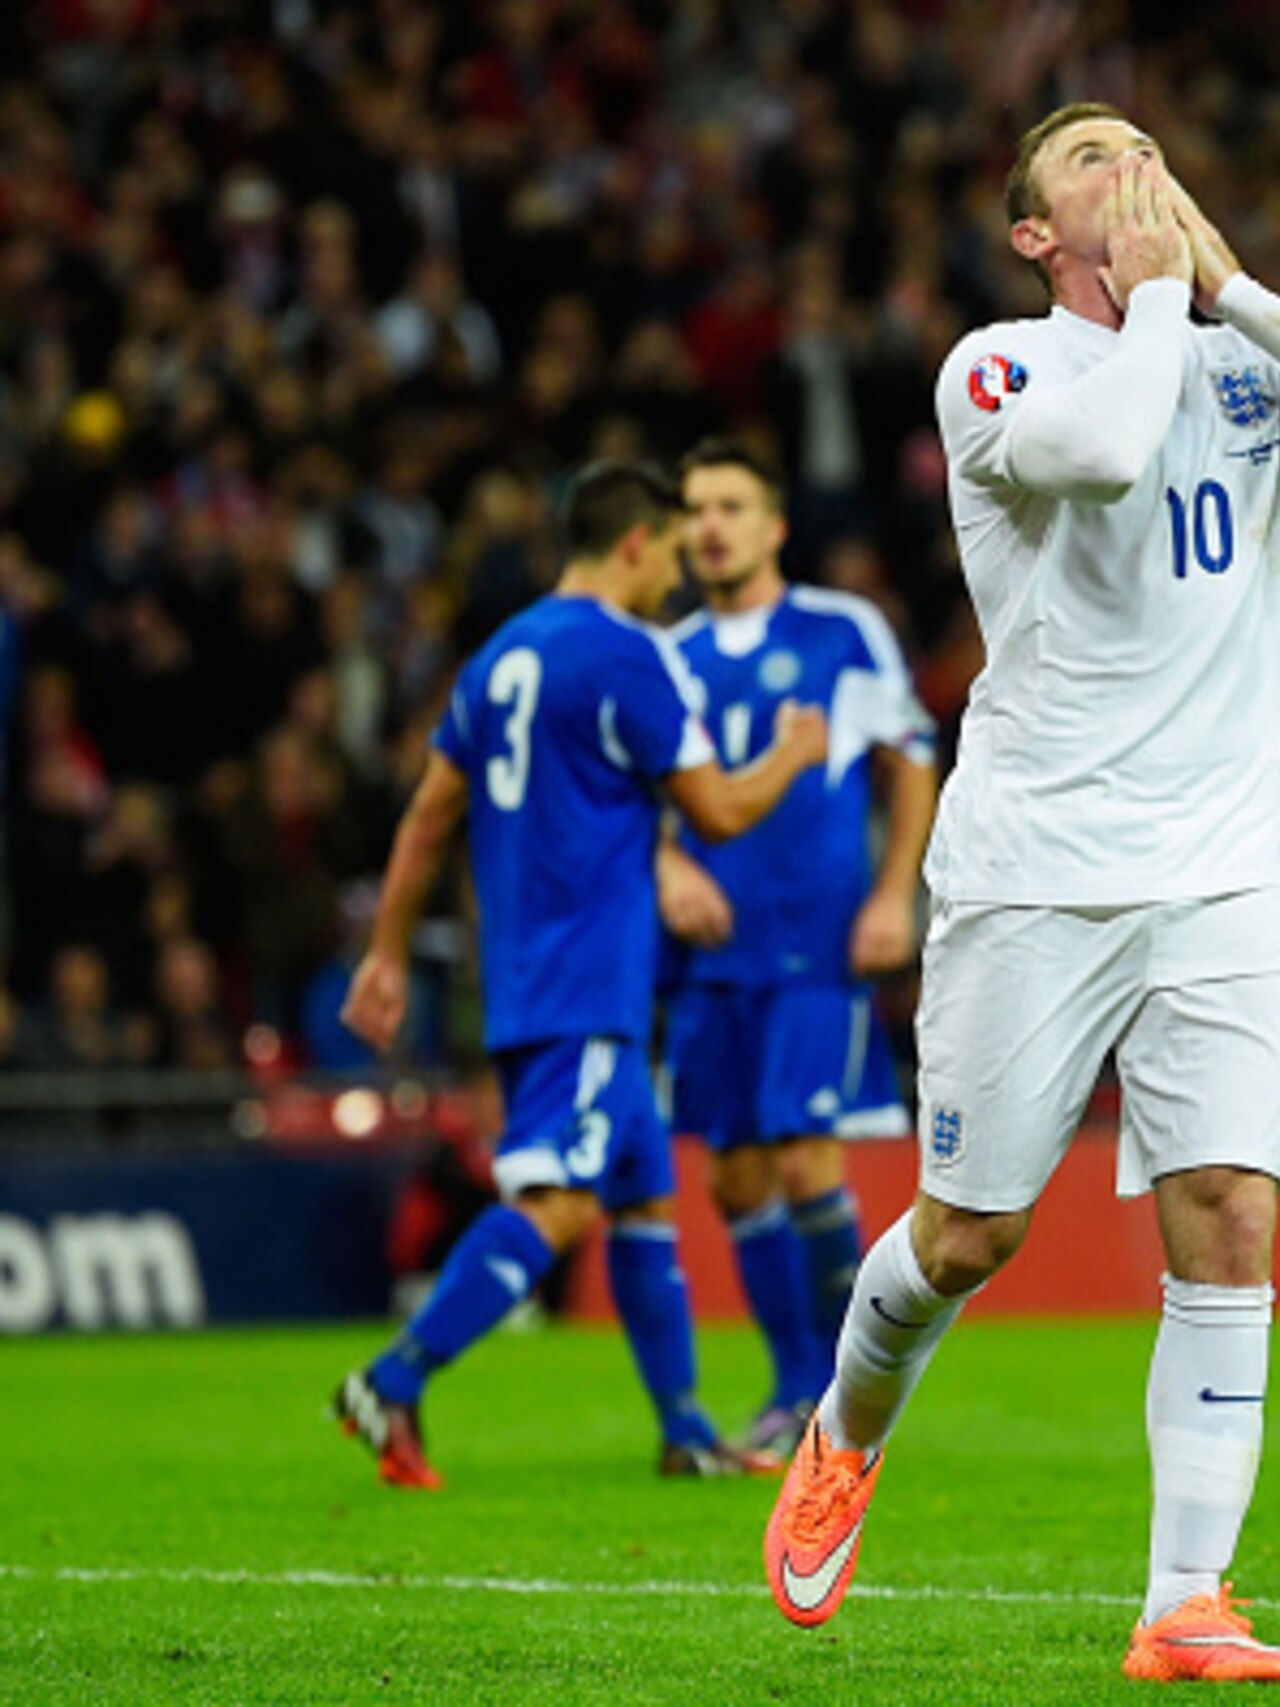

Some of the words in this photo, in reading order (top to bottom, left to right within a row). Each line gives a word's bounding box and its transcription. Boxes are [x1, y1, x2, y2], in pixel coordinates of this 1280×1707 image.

[1164, 478, 1234, 579] 10
[486, 645, 542, 812] 3
[566, 1108, 612, 1178] 3
